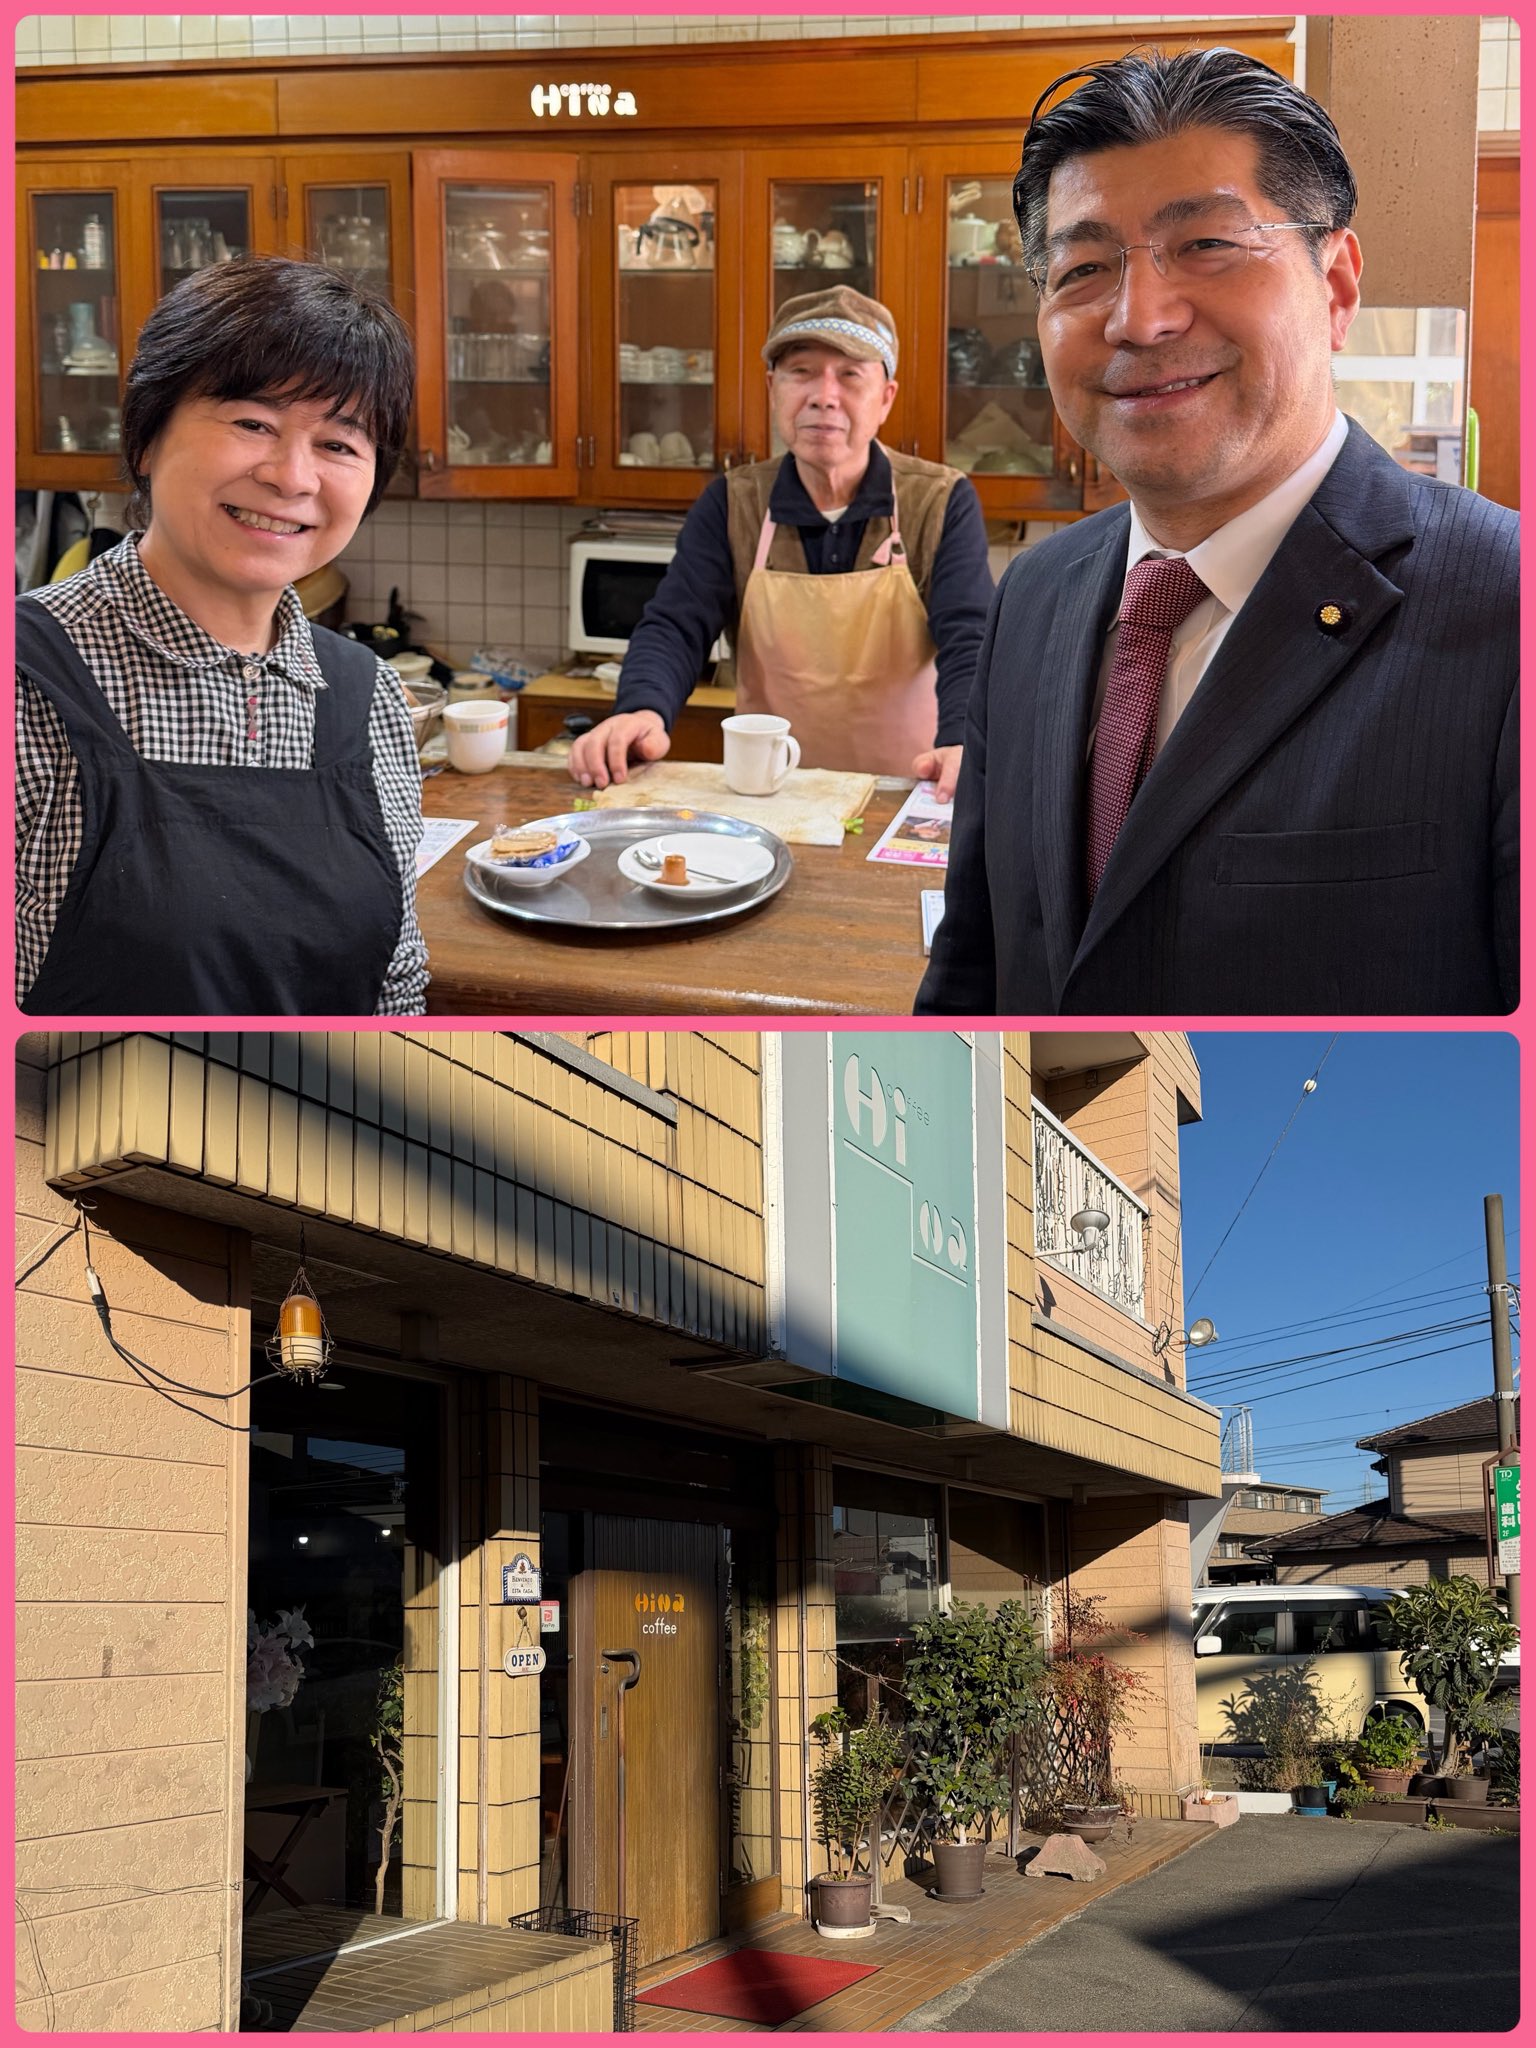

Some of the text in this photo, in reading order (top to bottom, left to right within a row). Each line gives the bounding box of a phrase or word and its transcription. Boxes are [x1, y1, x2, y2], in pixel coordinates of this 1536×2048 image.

[1501, 1503, 1516, 1528] 歯科
[642, 1617, 677, 1635] coffee
[511, 1653, 539, 1667] OPEN
